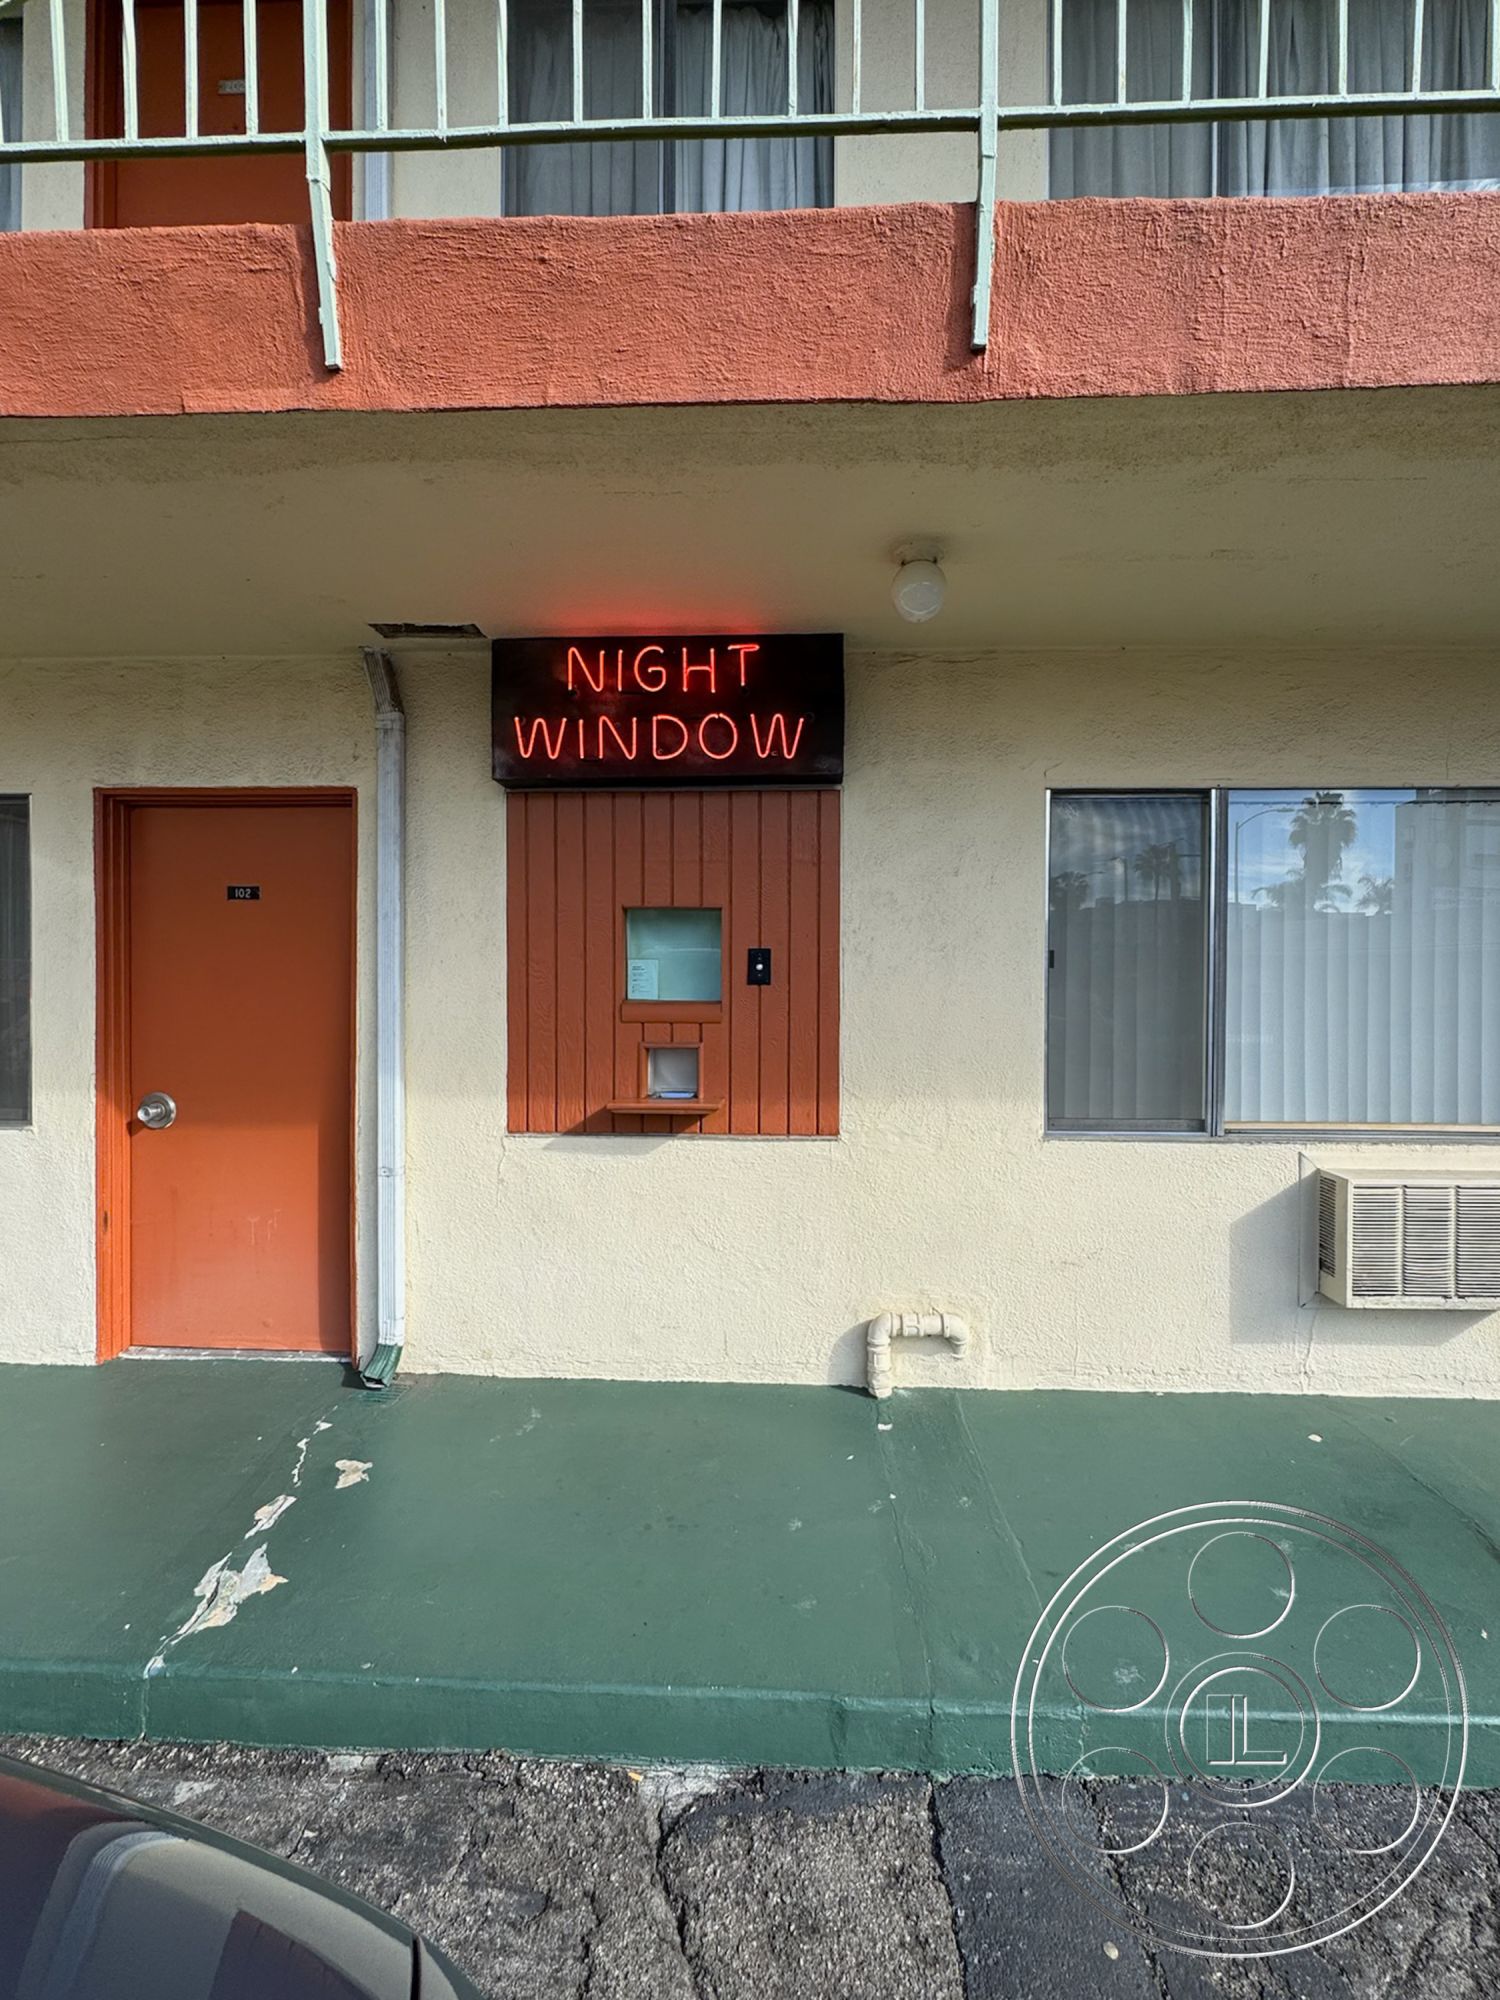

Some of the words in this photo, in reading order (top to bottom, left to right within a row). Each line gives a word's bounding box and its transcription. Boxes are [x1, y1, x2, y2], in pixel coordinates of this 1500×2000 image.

[567, 644, 760, 693] NIGHT
[514, 713, 804, 760] WINDOW
[235, 888, 251, 898] 102
